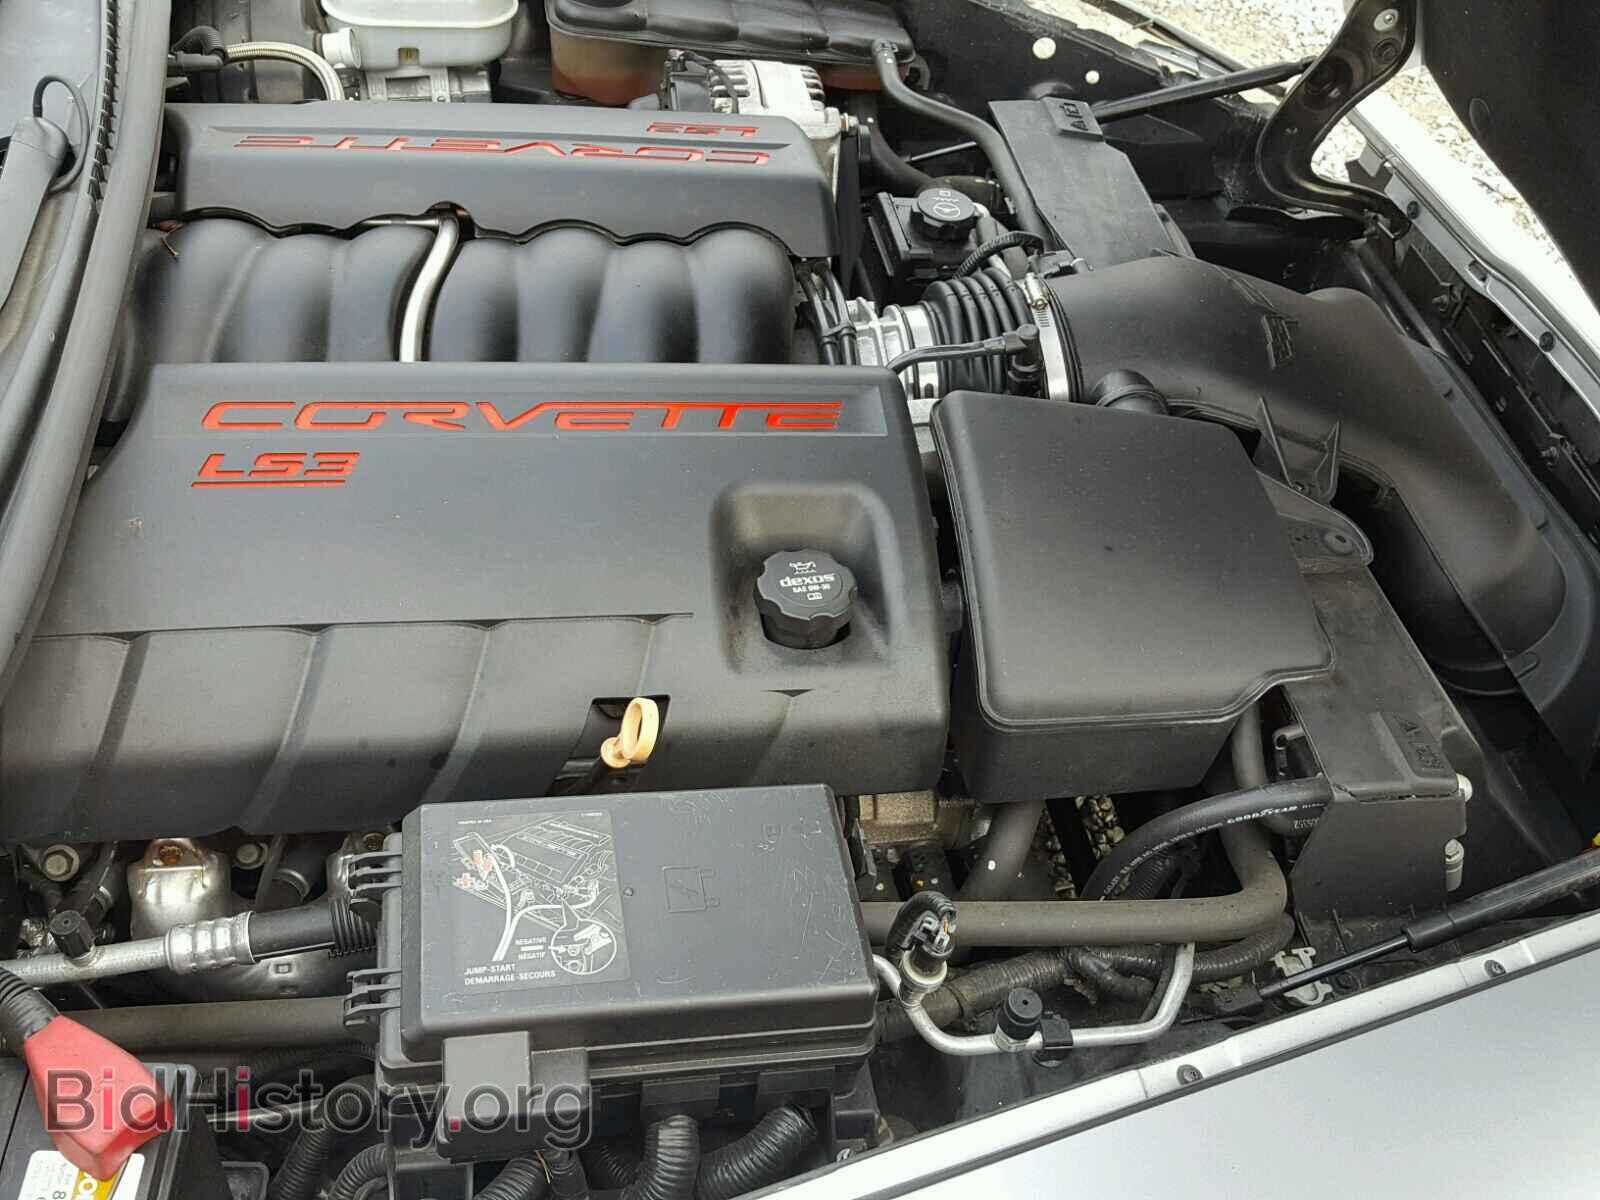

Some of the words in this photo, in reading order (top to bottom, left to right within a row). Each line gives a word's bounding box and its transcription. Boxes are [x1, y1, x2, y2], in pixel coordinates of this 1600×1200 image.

[645, 121, 760, 137] LS3
[234, 134, 770, 166] CORVETTE
[202, 400, 843, 431] CORVETTE
[194, 451, 361, 484] LS3
[779, 573, 835, 587] dexos
[515, 936, 547, 945] NEGATIVE
[464, 965, 516, 975] JUMP-START
